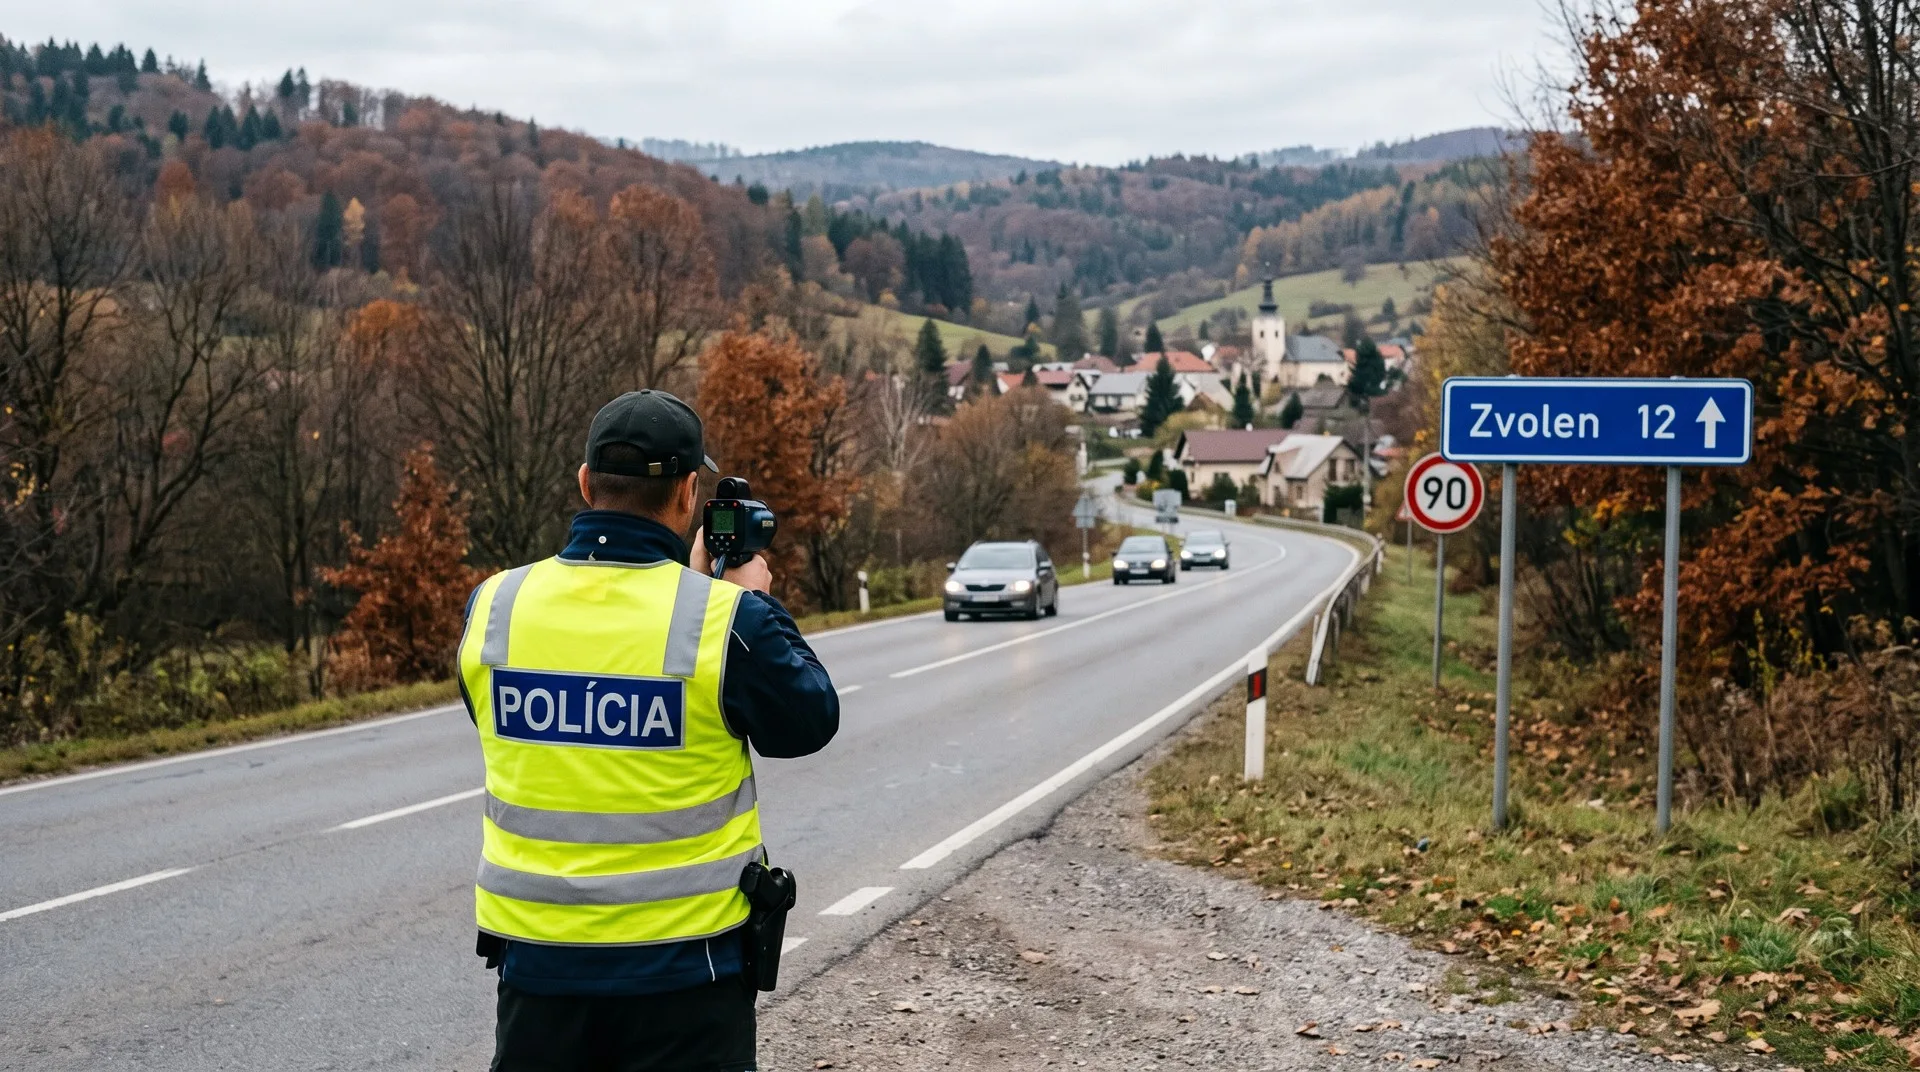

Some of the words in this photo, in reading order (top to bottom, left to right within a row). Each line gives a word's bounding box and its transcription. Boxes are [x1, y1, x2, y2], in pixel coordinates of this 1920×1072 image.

[1469, 403, 1600, 438] Zvolen
[1637, 404, 1676, 439] 12
[1423, 476, 1467, 510] 90
[498, 680, 675, 738] POLÍCIA
